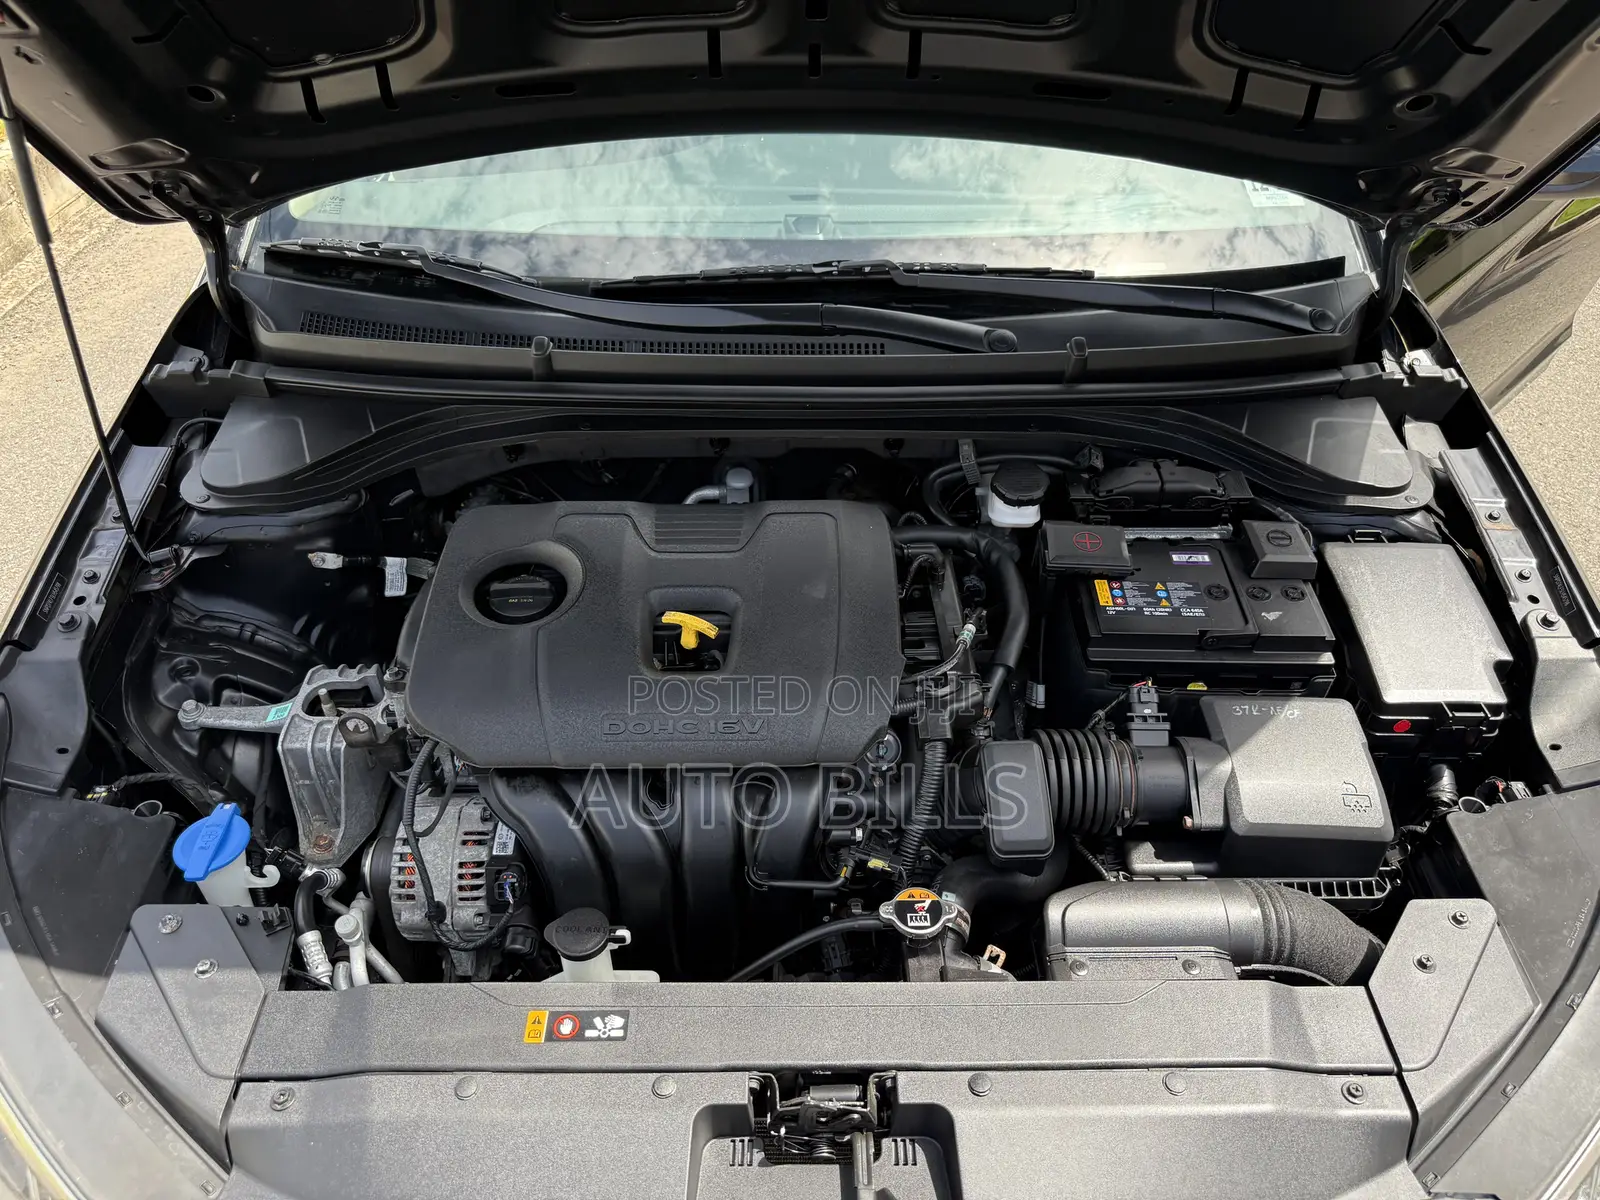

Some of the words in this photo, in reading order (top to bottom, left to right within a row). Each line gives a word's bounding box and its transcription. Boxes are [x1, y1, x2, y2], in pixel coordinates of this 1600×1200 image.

[602, 719, 699, 735] DOHC
[707, 719, 766, 735] 16V
[555, 925, 608, 934] COOLANT
